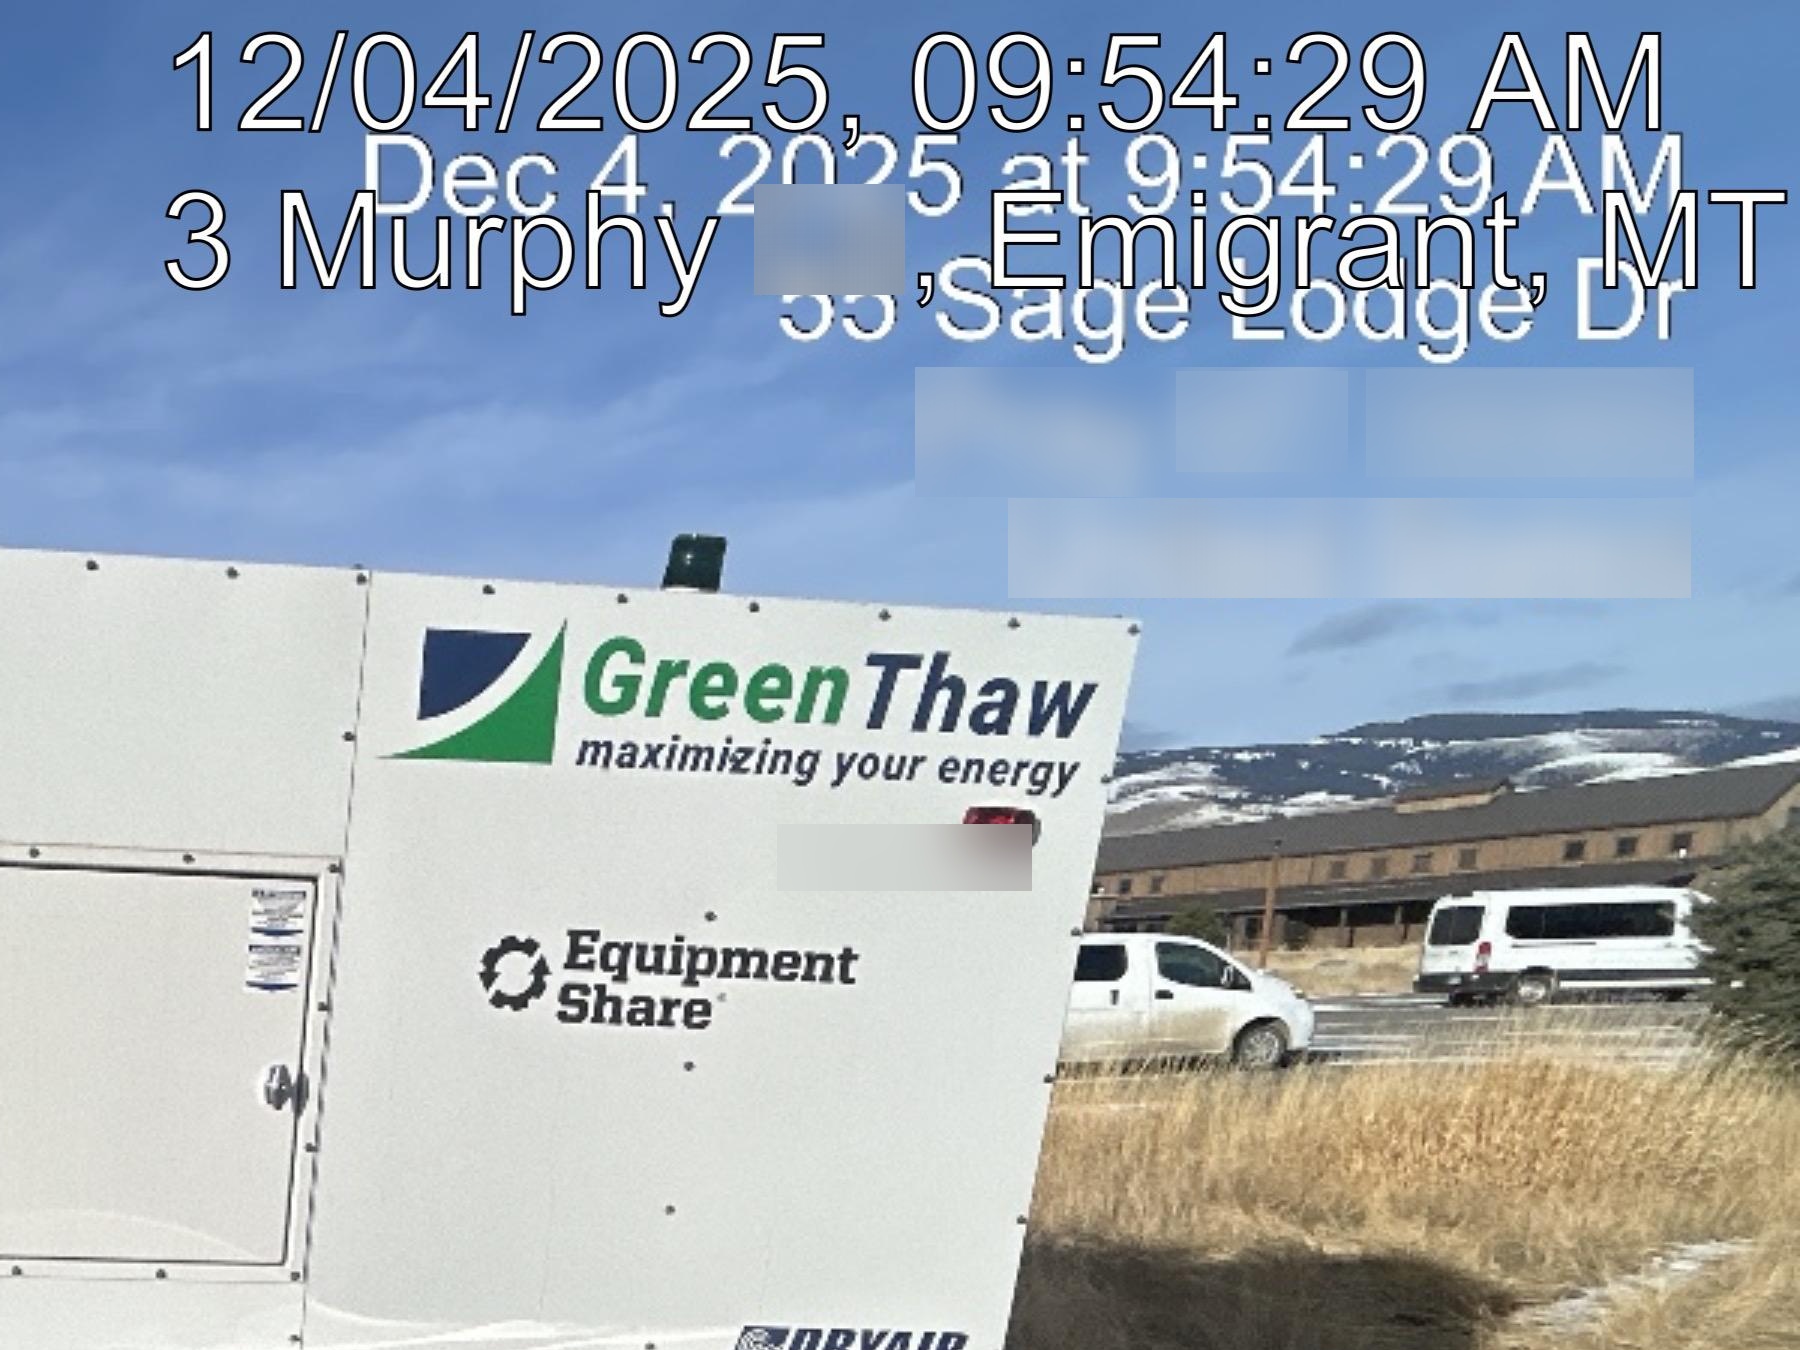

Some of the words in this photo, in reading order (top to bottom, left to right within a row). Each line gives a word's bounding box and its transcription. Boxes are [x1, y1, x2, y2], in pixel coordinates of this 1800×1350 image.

[575, 734, 821, 788] maximizing
[830, 750, 927, 788] your
[937, 756, 1082, 798] energy
[563, 928, 859, 987] Equipment
[556, 982, 713, 1030] Share
